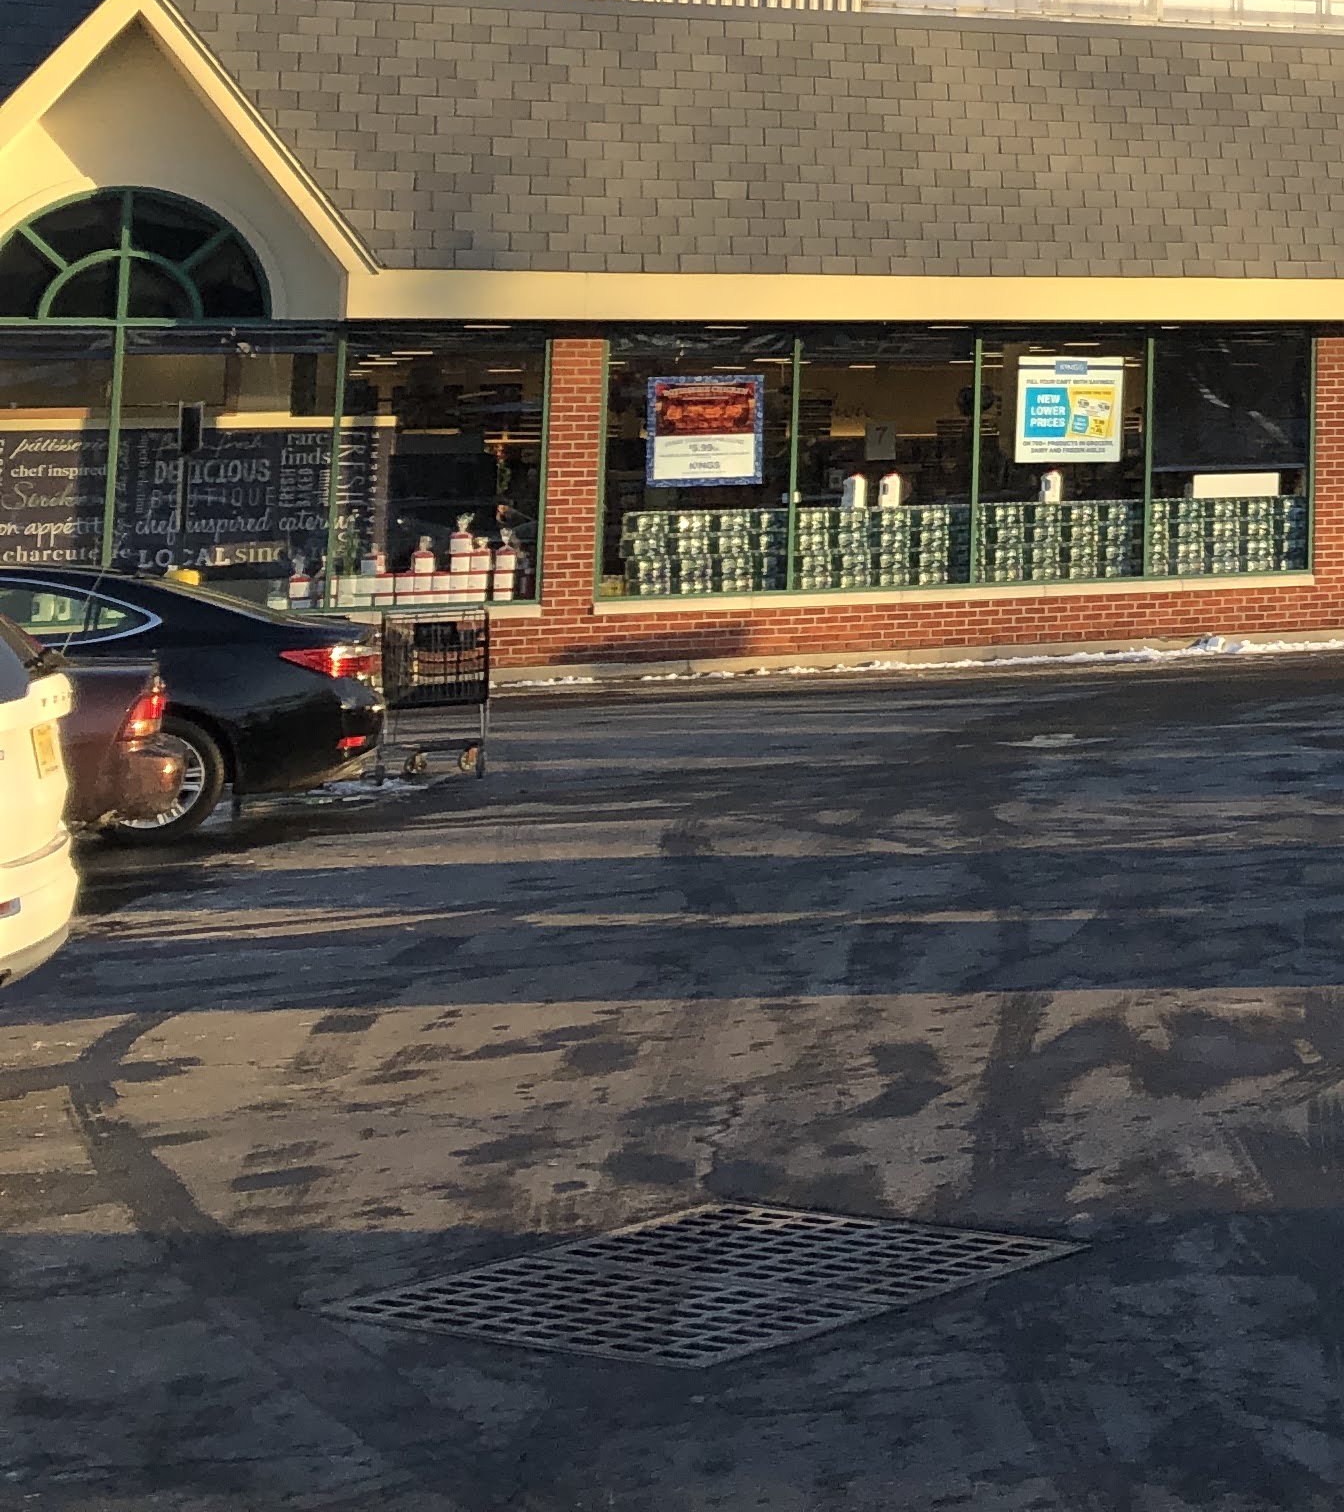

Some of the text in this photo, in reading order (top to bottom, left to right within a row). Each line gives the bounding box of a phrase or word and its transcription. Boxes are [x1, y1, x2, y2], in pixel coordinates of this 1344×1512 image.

[1037, 394, 1060, 404] NEW
[1030, 405, 1066, 416] LOWER
[1029, 417, 1066, 428] PRICES
[280, 447, 332, 465] finds
[10, 464, 47, 478] chef
[154, 458, 271, 484] DEICIOUS
